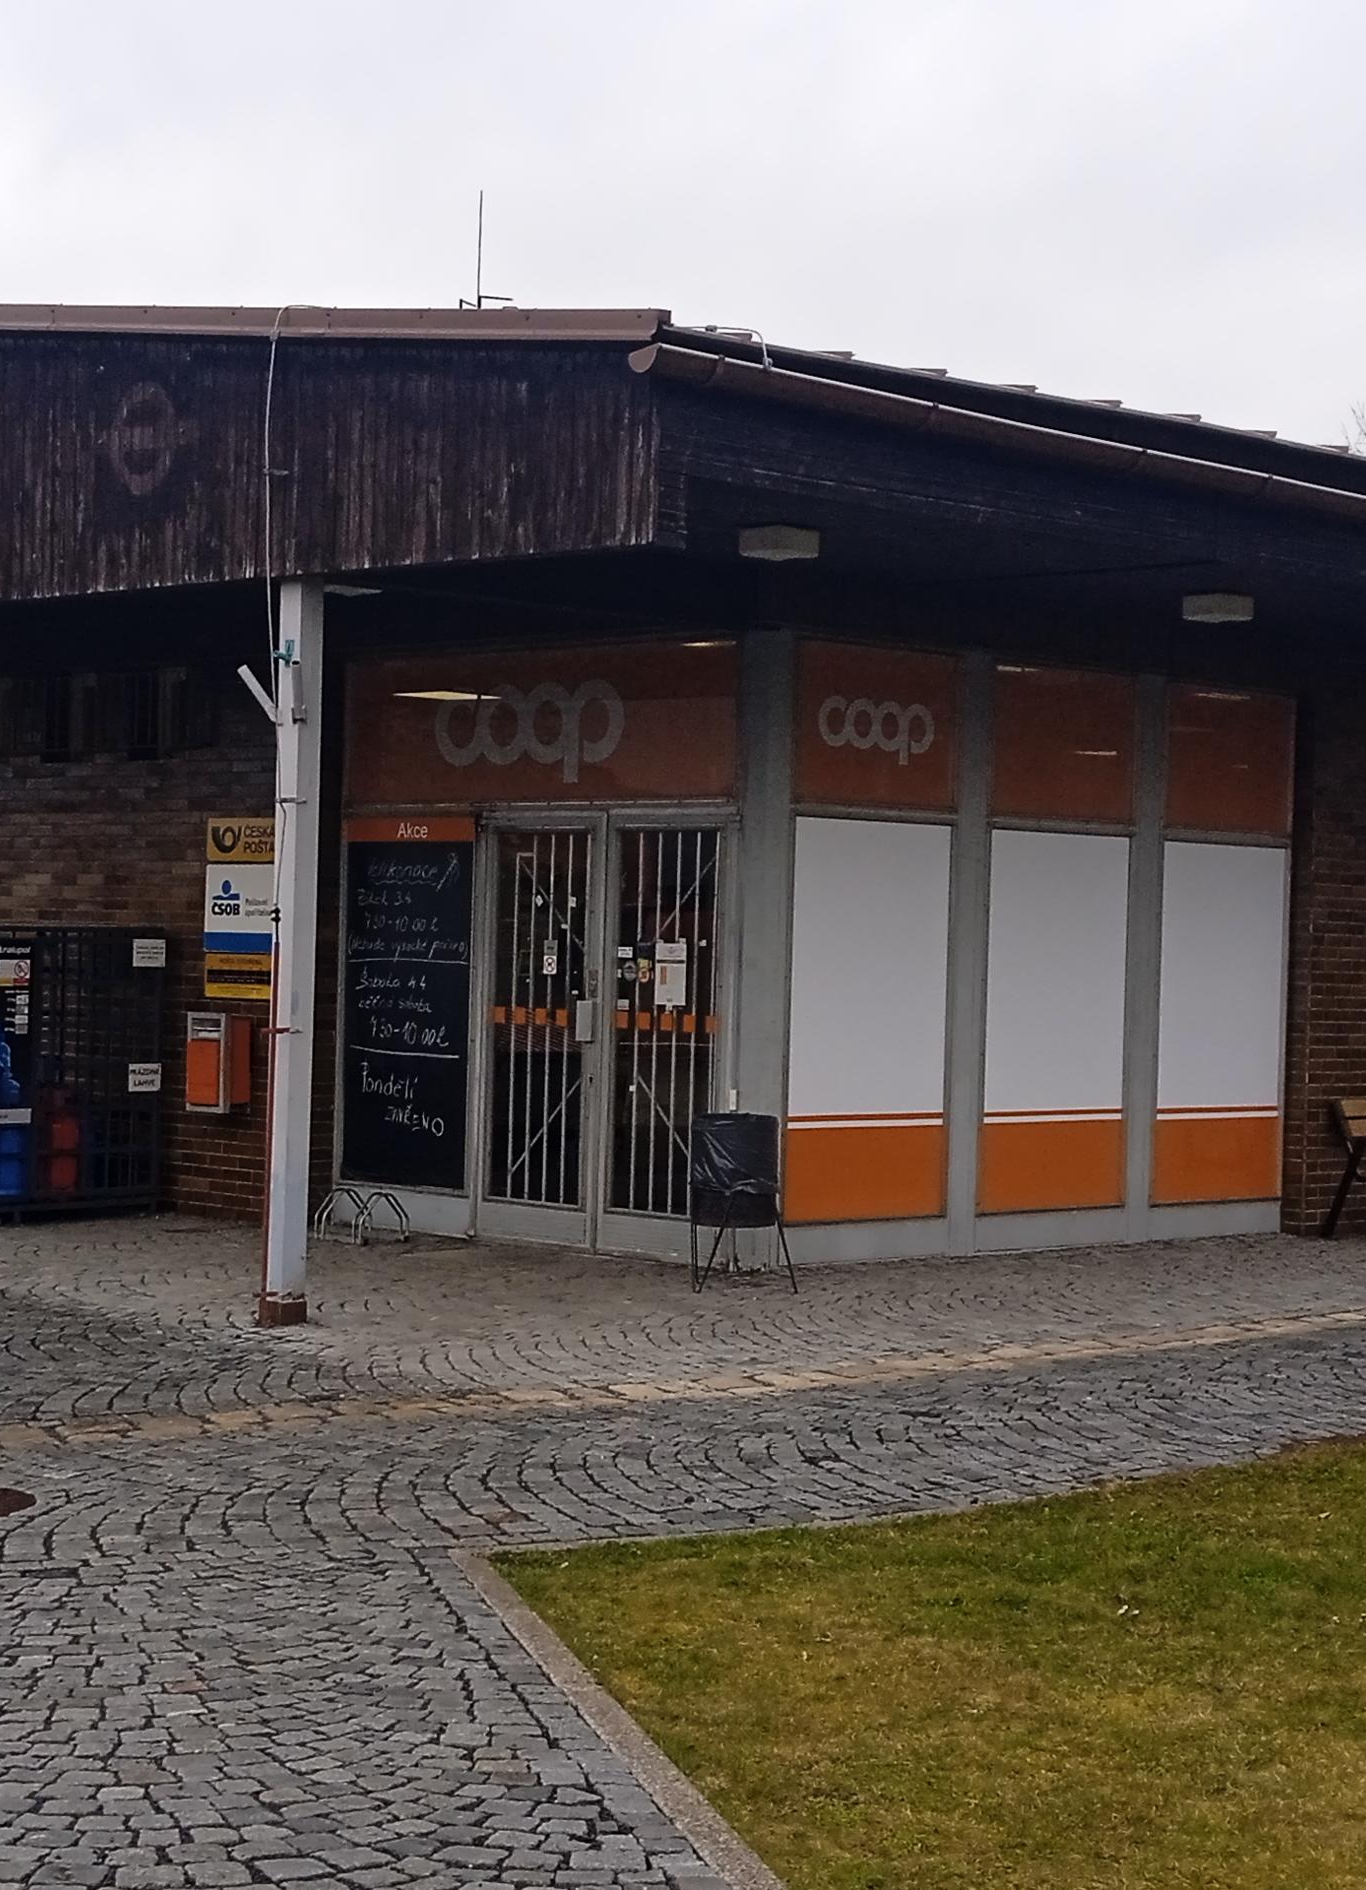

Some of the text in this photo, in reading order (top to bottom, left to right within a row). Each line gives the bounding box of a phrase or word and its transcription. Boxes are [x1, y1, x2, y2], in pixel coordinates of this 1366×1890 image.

[435, 680, 625, 783] coop
[819, 695, 934, 765] coop
[397, 822, 428, 838] Akce
[243, 839, 275, 854] POŠTA
[212, 902, 240, 916] ČSOB
